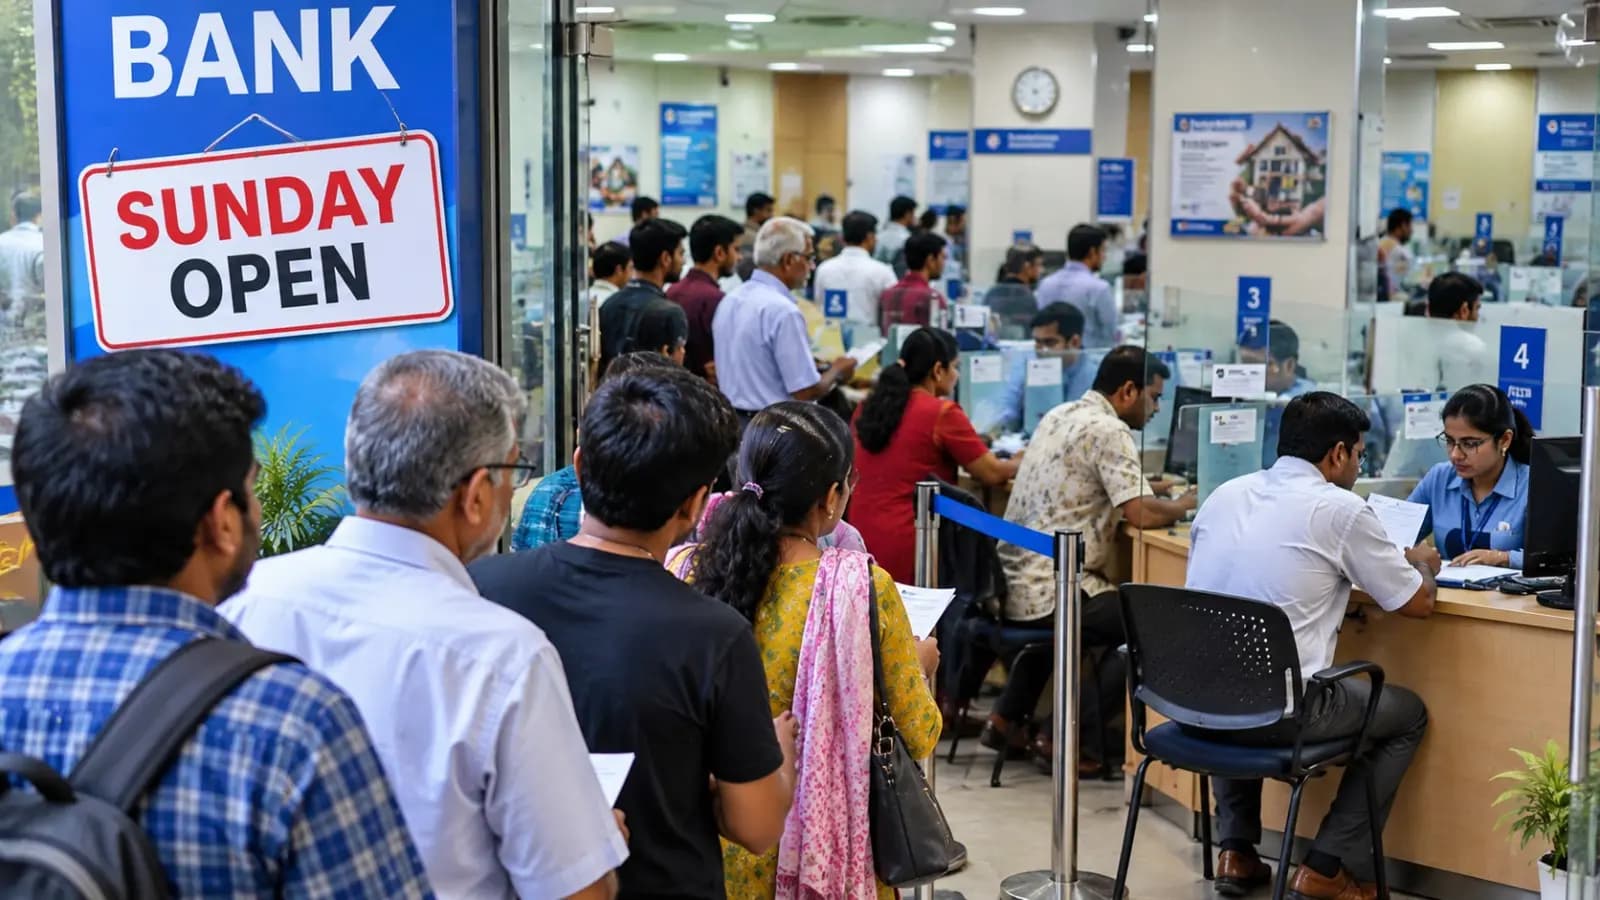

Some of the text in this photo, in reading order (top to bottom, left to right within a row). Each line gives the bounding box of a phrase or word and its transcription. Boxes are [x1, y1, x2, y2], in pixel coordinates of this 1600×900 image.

[111, 5, 400, 99] BANK
[117, 164, 405, 250] SUNDAY
[170, 242, 370, 319] OPEN
[1247, 286, 1260, 309] 3
[1513, 343, 1529, 370] 4
